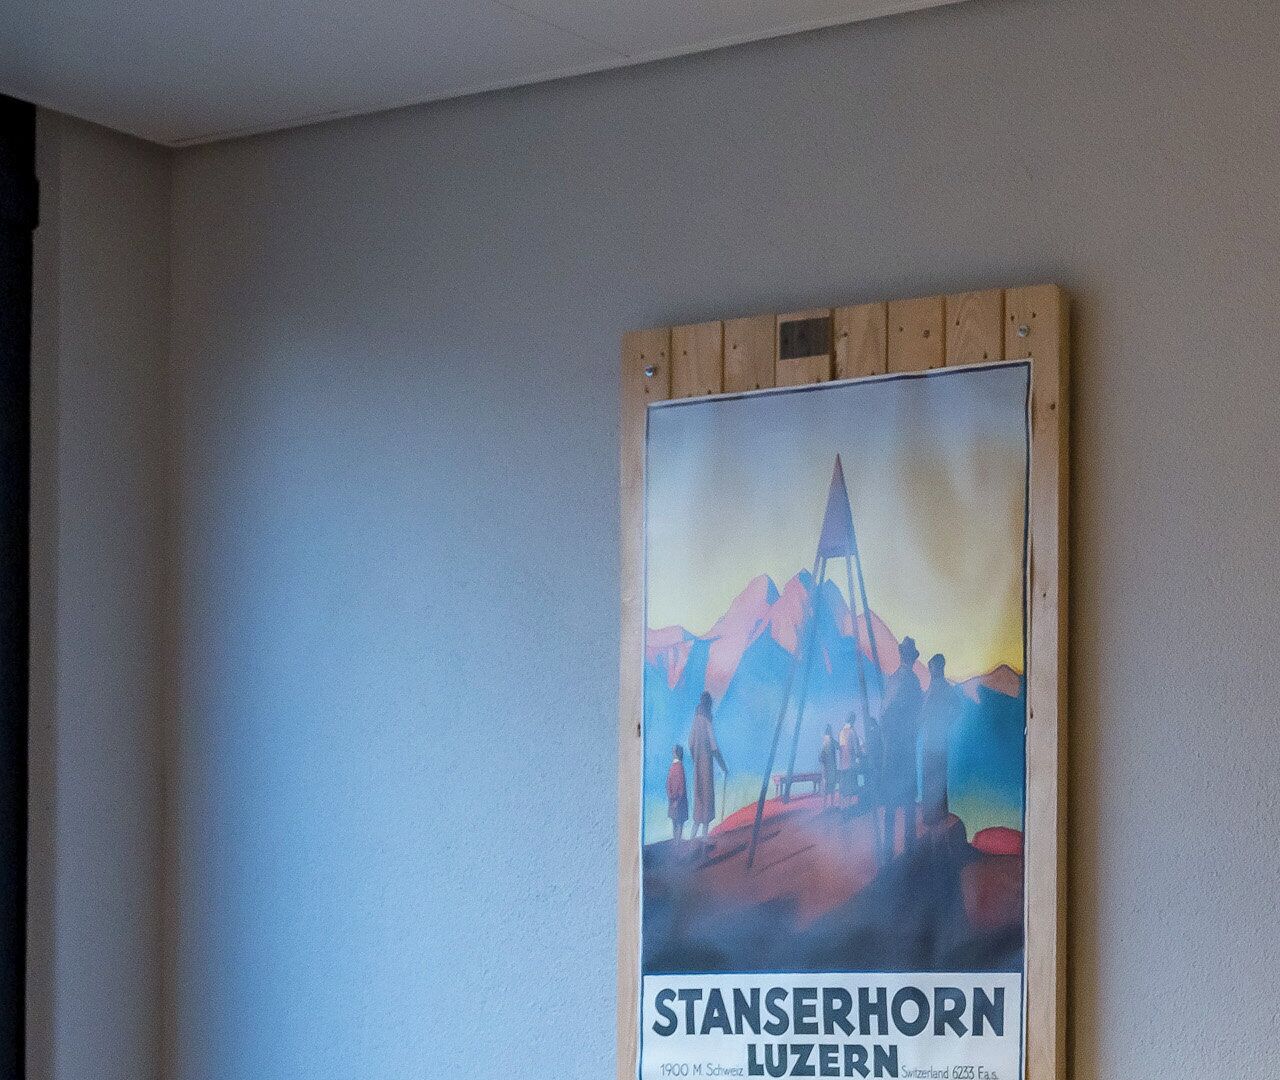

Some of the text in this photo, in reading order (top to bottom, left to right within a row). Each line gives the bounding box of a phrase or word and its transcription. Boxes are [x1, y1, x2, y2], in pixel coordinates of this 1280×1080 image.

[652, 986, 1005, 1038] STANSERHORN
[659, 1062, 689, 1077] 1900
[706, 1062, 744, 1077] Schweiz
[747, 1043, 899, 1079] LUZERN
[901, 1065, 949, 1079] Switzerland
[952, 1065, 975, 1080] 6233
